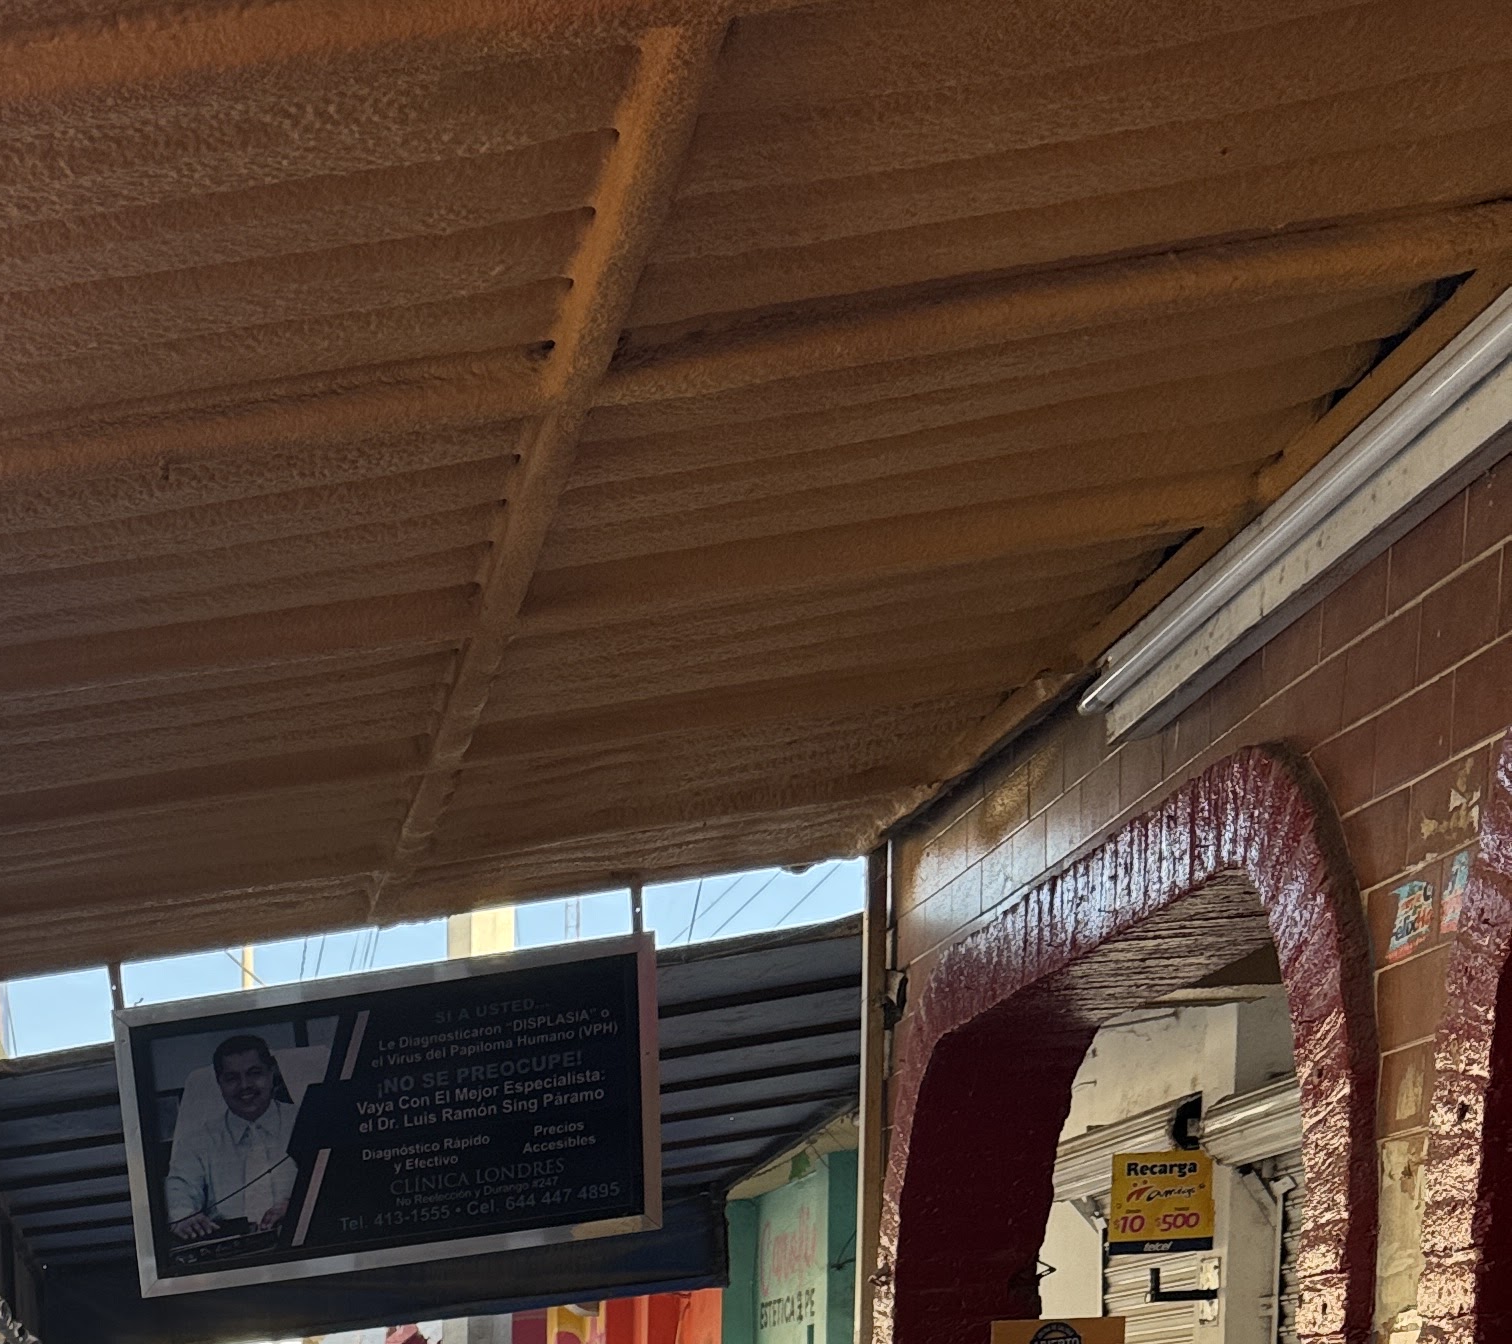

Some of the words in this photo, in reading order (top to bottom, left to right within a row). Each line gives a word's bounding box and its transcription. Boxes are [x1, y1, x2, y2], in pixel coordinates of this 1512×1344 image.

[434, 1010, 452, 1024] SI
[457, 1007, 470, 1020] A
[371, 1056, 383, 1068] el
[386, 1050, 421, 1066] Virus
[425, 1046, 445, 1060] del
[450, 1036, 512, 1059] Papiloma
[517, 1027, 574, 1047] Humano
[578, 1020, 618, 1040] (VPH)
[378, 1038, 395, 1051] Le
[398, 1022, 501, 1050] Diagnosticaron
[422, 1069, 449, 1089] SE
[456, 1048, 582, 1083] PREOCUPE!
[356, 1097, 393, 1118] Vaya
[398, 1092, 430, 1110] Con
[434, 1089, 450, 1105] El
[454, 1082, 498, 1105] Mejor
[503, 1066, 605, 1097] Especialista:
[358, 1119, 373, 1133] el
[376, 1116, 398, 1131] Dr.
[403, 1110, 437, 1127] Luis
[441, 1100, 496, 1121] Ramón
[501, 1095, 537, 1116] Sing
[543, 1084, 604, 1107] Páramo
[533, 1118, 584, 1137] Precios
[361, 1139, 440, 1163] Diagnóstico
[443, 1131, 490, 1151] Rápido
[522, 1132, 596, 1154] Accesibles
[389, 1168, 470, 1196] CLÍNICA
[475, 1156, 565, 1185] LONDRES
[393, 1162, 401, 1174] y
[404, 1152, 458, 1171] Efectivo
[1126, 1162, 1198, 1178] Recarga
[483, 1179, 528, 1197] Durango
[339, 1214, 366, 1232] Tel.
[372, 1203, 450, 1227] 413-1555
[466, 1197, 499, 1215] Cel.
[505, 1192, 536, 1210] 644
[540, 1187, 571, 1205] 447
[576, 1180, 620, 1200] 4895
[1143, 1241, 1174, 1252] telcel
